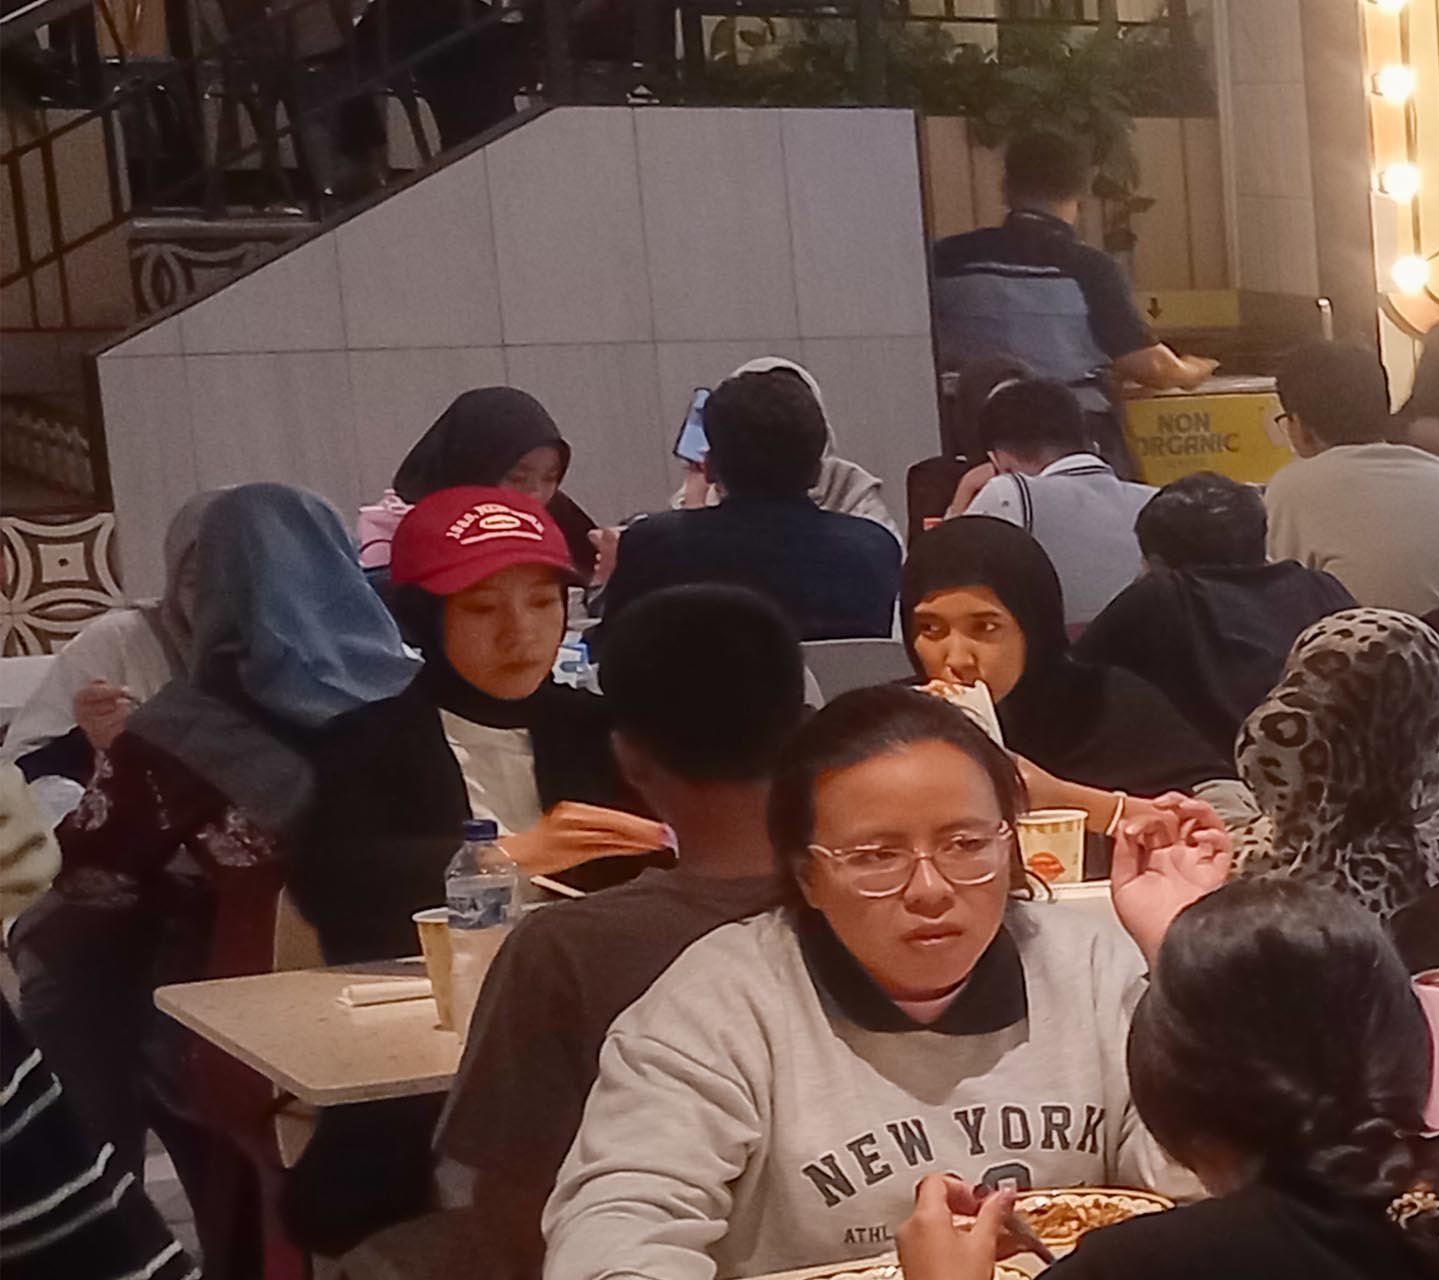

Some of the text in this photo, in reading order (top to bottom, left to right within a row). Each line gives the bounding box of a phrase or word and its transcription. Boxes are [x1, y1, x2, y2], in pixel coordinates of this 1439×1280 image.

[1157, 413, 1211, 434] NON
[802, 1116, 935, 1207] NEW
[953, 1104, 1105, 1157] YORK
[844, 1226, 896, 1246] ATHL
